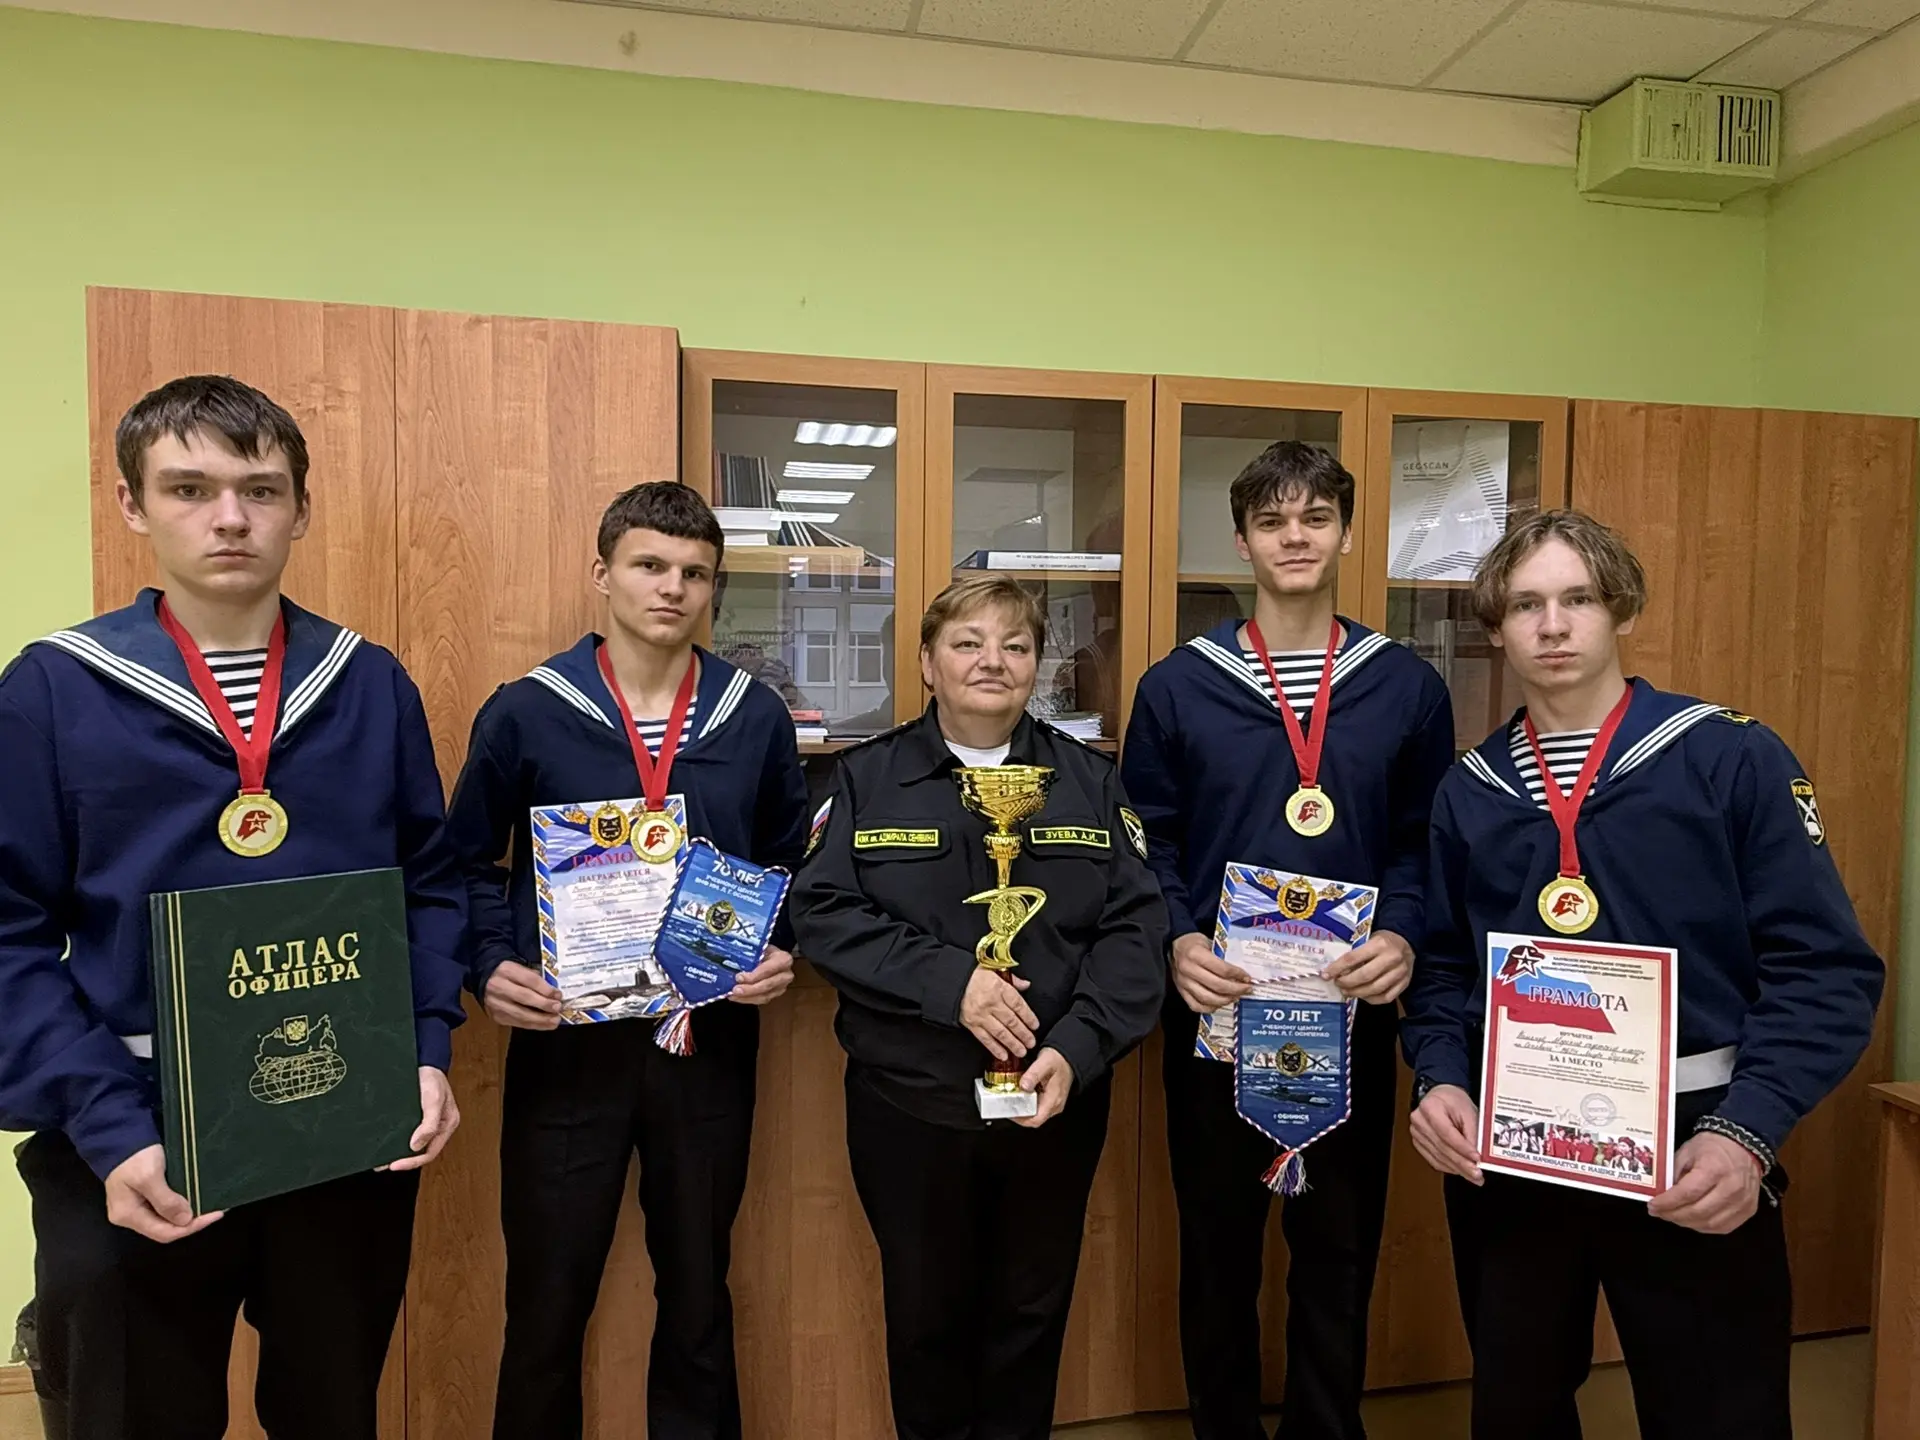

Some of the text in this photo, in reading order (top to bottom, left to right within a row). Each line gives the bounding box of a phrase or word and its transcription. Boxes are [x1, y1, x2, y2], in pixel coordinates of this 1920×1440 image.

[1402, 461, 1450, 471] GEOSCAN
[1045, 830, 1099, 842] ЗУЕВА А.И.
[571, 851, 640, 869] ГРАМО
[712, 860, 731, 877] 70
[578, 868, 651, 883] НАГРАЖДАЕТСЯ
[1251, 916, 1335, 942] ГРАМОТА
[1254, 935, 1325, 955] НАГРАЖДАЕТСЯ
[228, 931, 361, 978] АТЛАС
[228, 960, 362, 999] ОФИЦЕРА
[1528, 985, 1629, 1012] ГРАМОТА
[1263, 1009, 1322, 1022] 70 ЛЕТ
[1549, 1054, 1560, 1062] ЗА
[1568, 1057, 1603, 1068] МЕСТО
[1501, 1150, 1531, 1161] РОДИНА
[1532, 1155, 1579, 1169] НАЧИНАЕТСЯ
[1588, 1165, 1615, 1177] НАШИХ
[1617, 1171, 1643, 1181] ДЕТЕЙ
